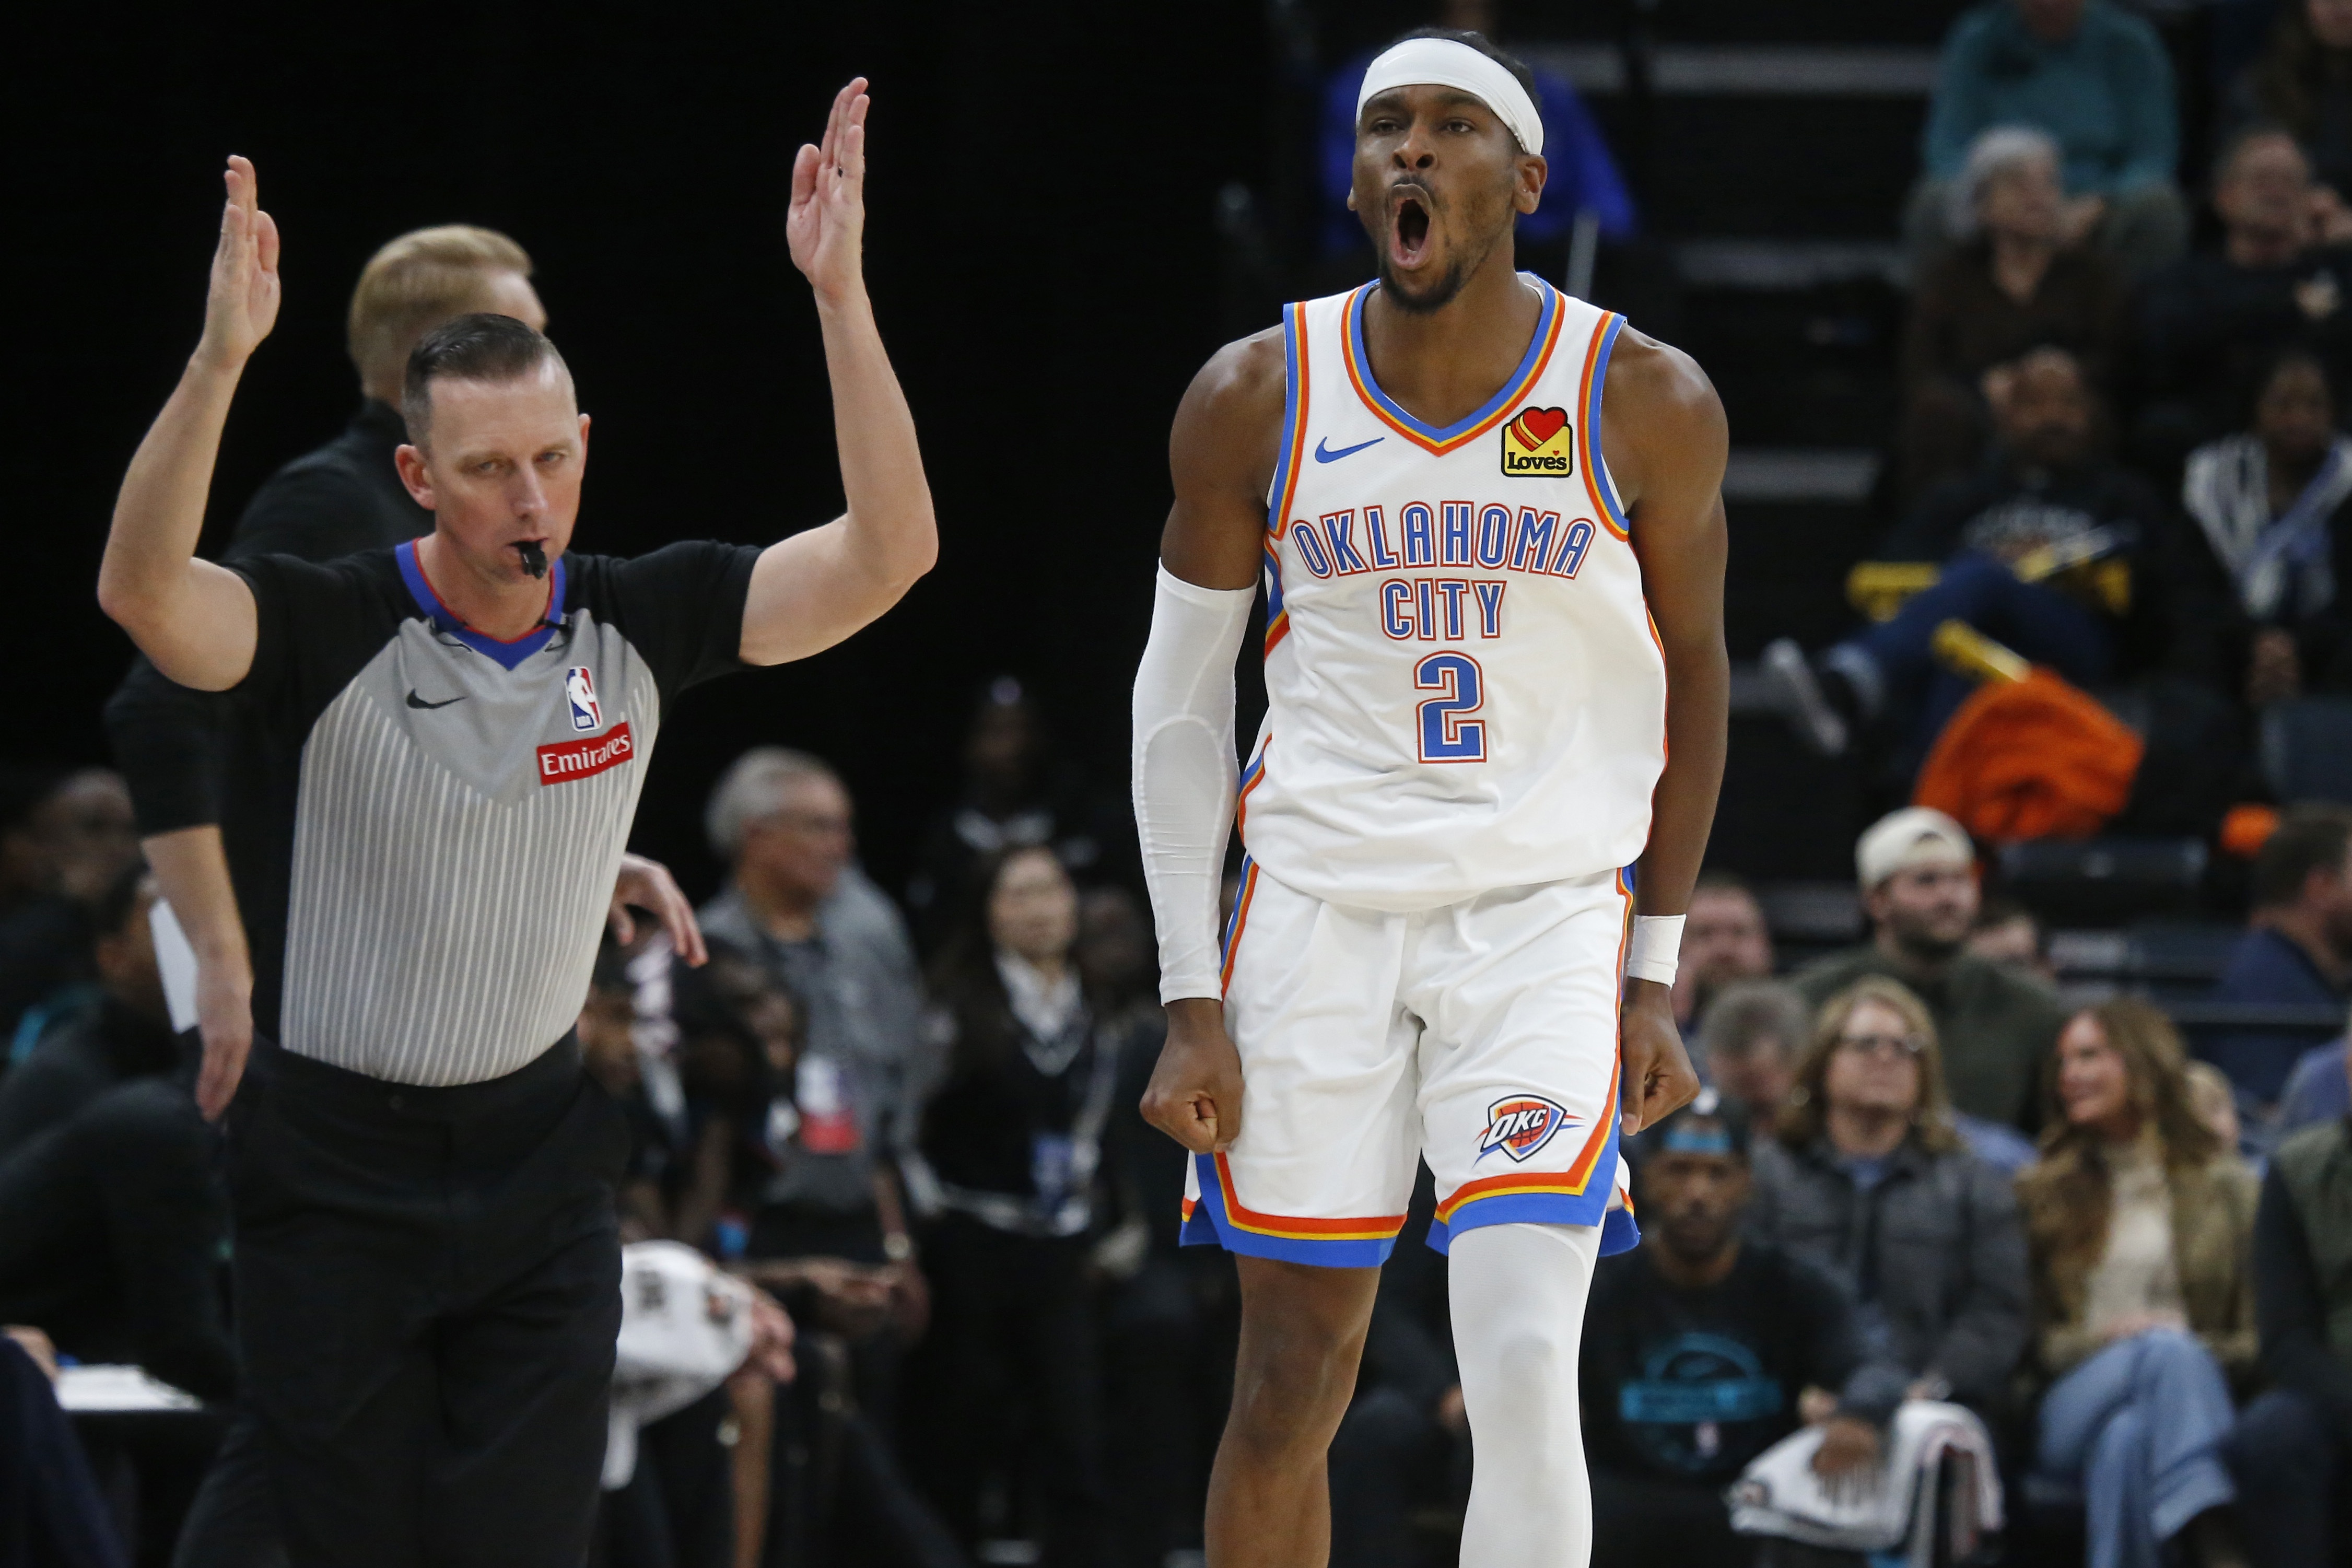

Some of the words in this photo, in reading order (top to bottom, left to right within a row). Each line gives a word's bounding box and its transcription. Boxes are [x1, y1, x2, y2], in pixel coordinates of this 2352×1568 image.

[1290, 500, 1596, 580] OKLAHOMA
[1379, 578, 1507, 641] CITY
[1413, 650, 1488, 764] 2
[541, 734, 630, 776] Emirates
[1481, 1108, 1548, 1151] OKC
